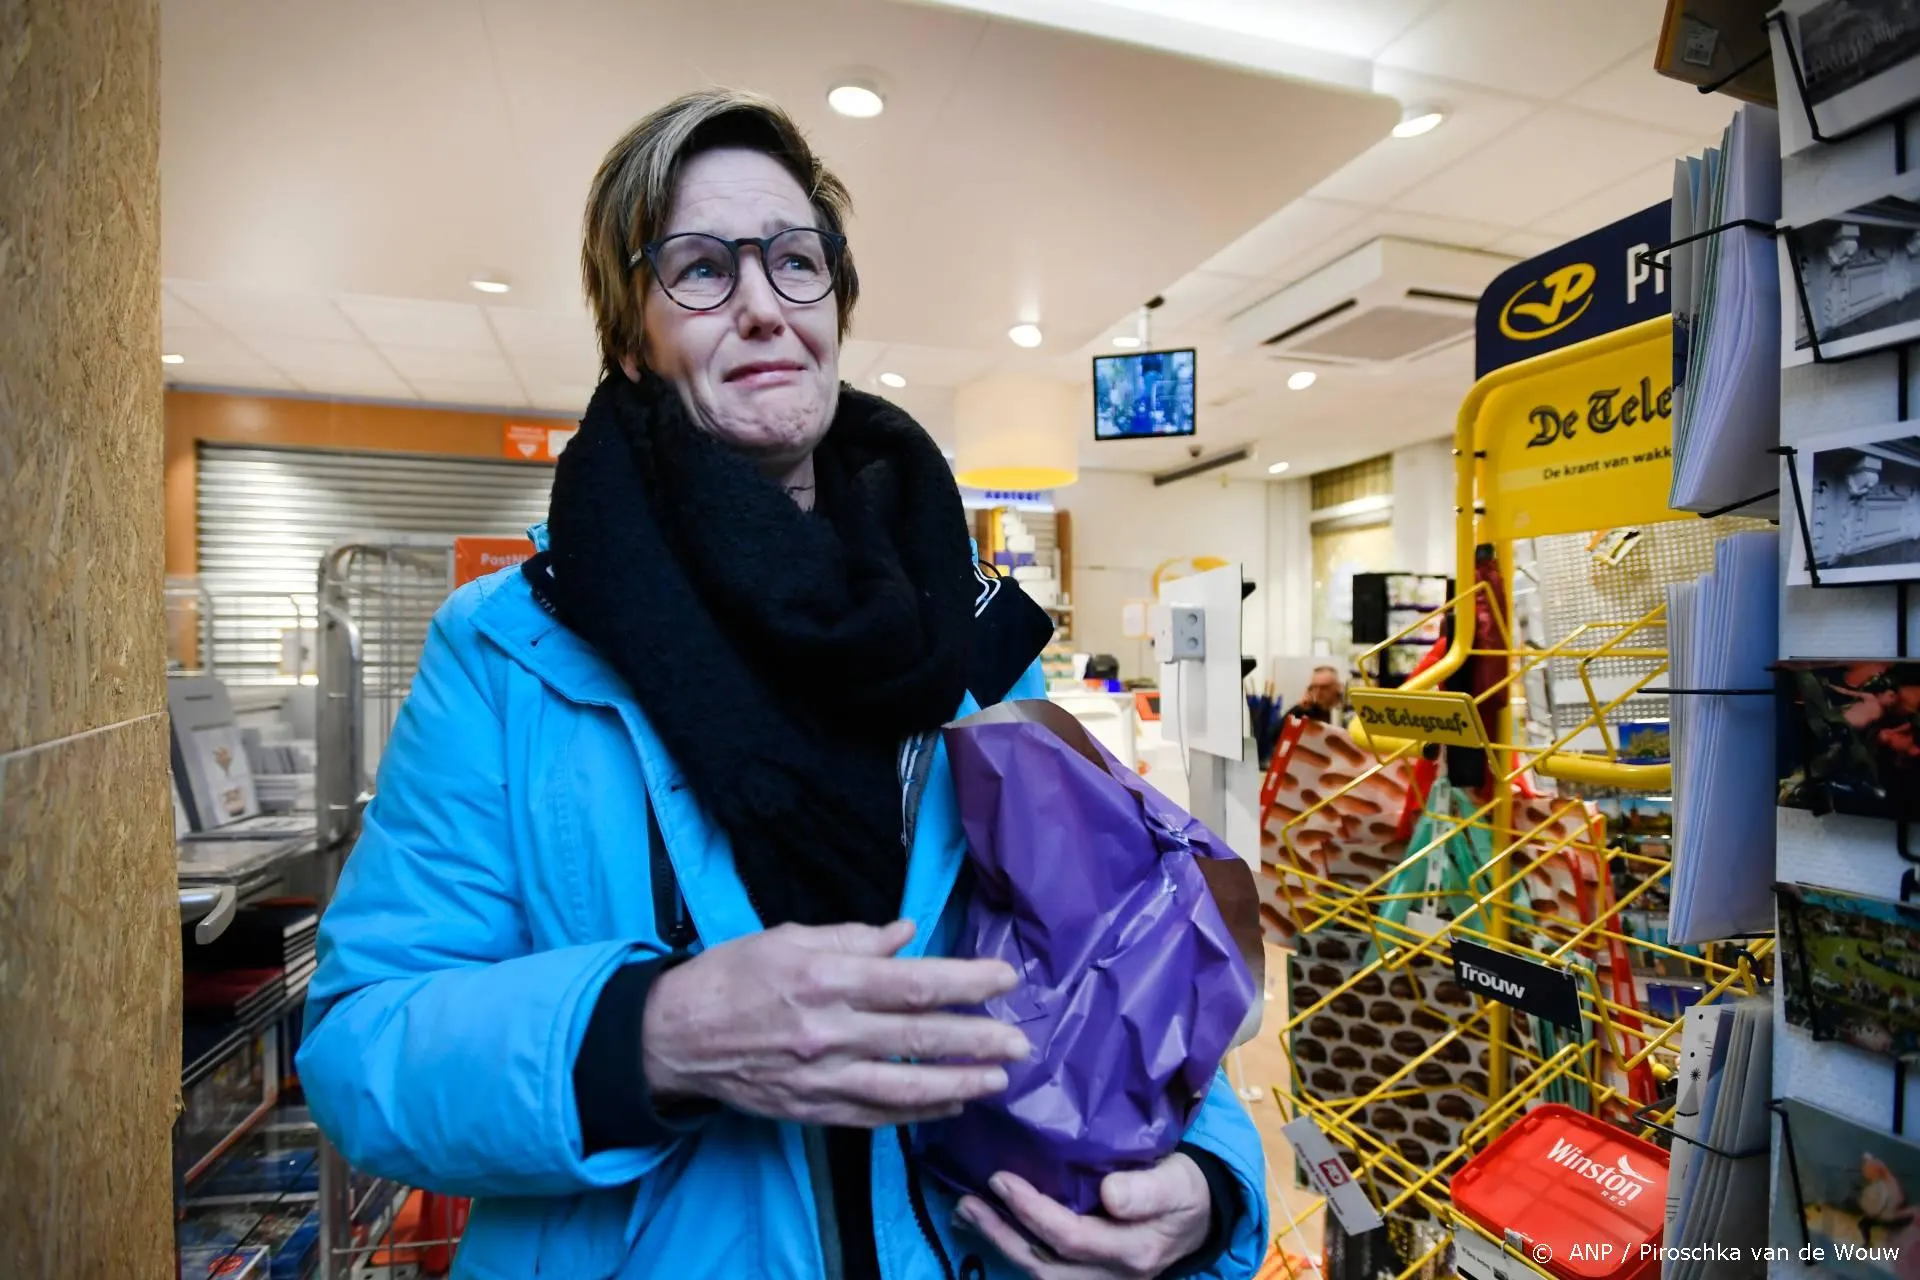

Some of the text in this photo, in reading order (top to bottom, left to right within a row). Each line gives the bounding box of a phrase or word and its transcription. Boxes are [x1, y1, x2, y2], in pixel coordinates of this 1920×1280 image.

[1526, 405, 1579, 449] De
[1543, 467, 1561, 480] De
[1564, 459, 1600, 476] krant
[1603, 455, 1629, 469] van
[1459, 961, 1526, 1000] Trouw
[1547, 1137, 1643, 1201] Winston
[1601, 1190, 1627, 1207] RED
